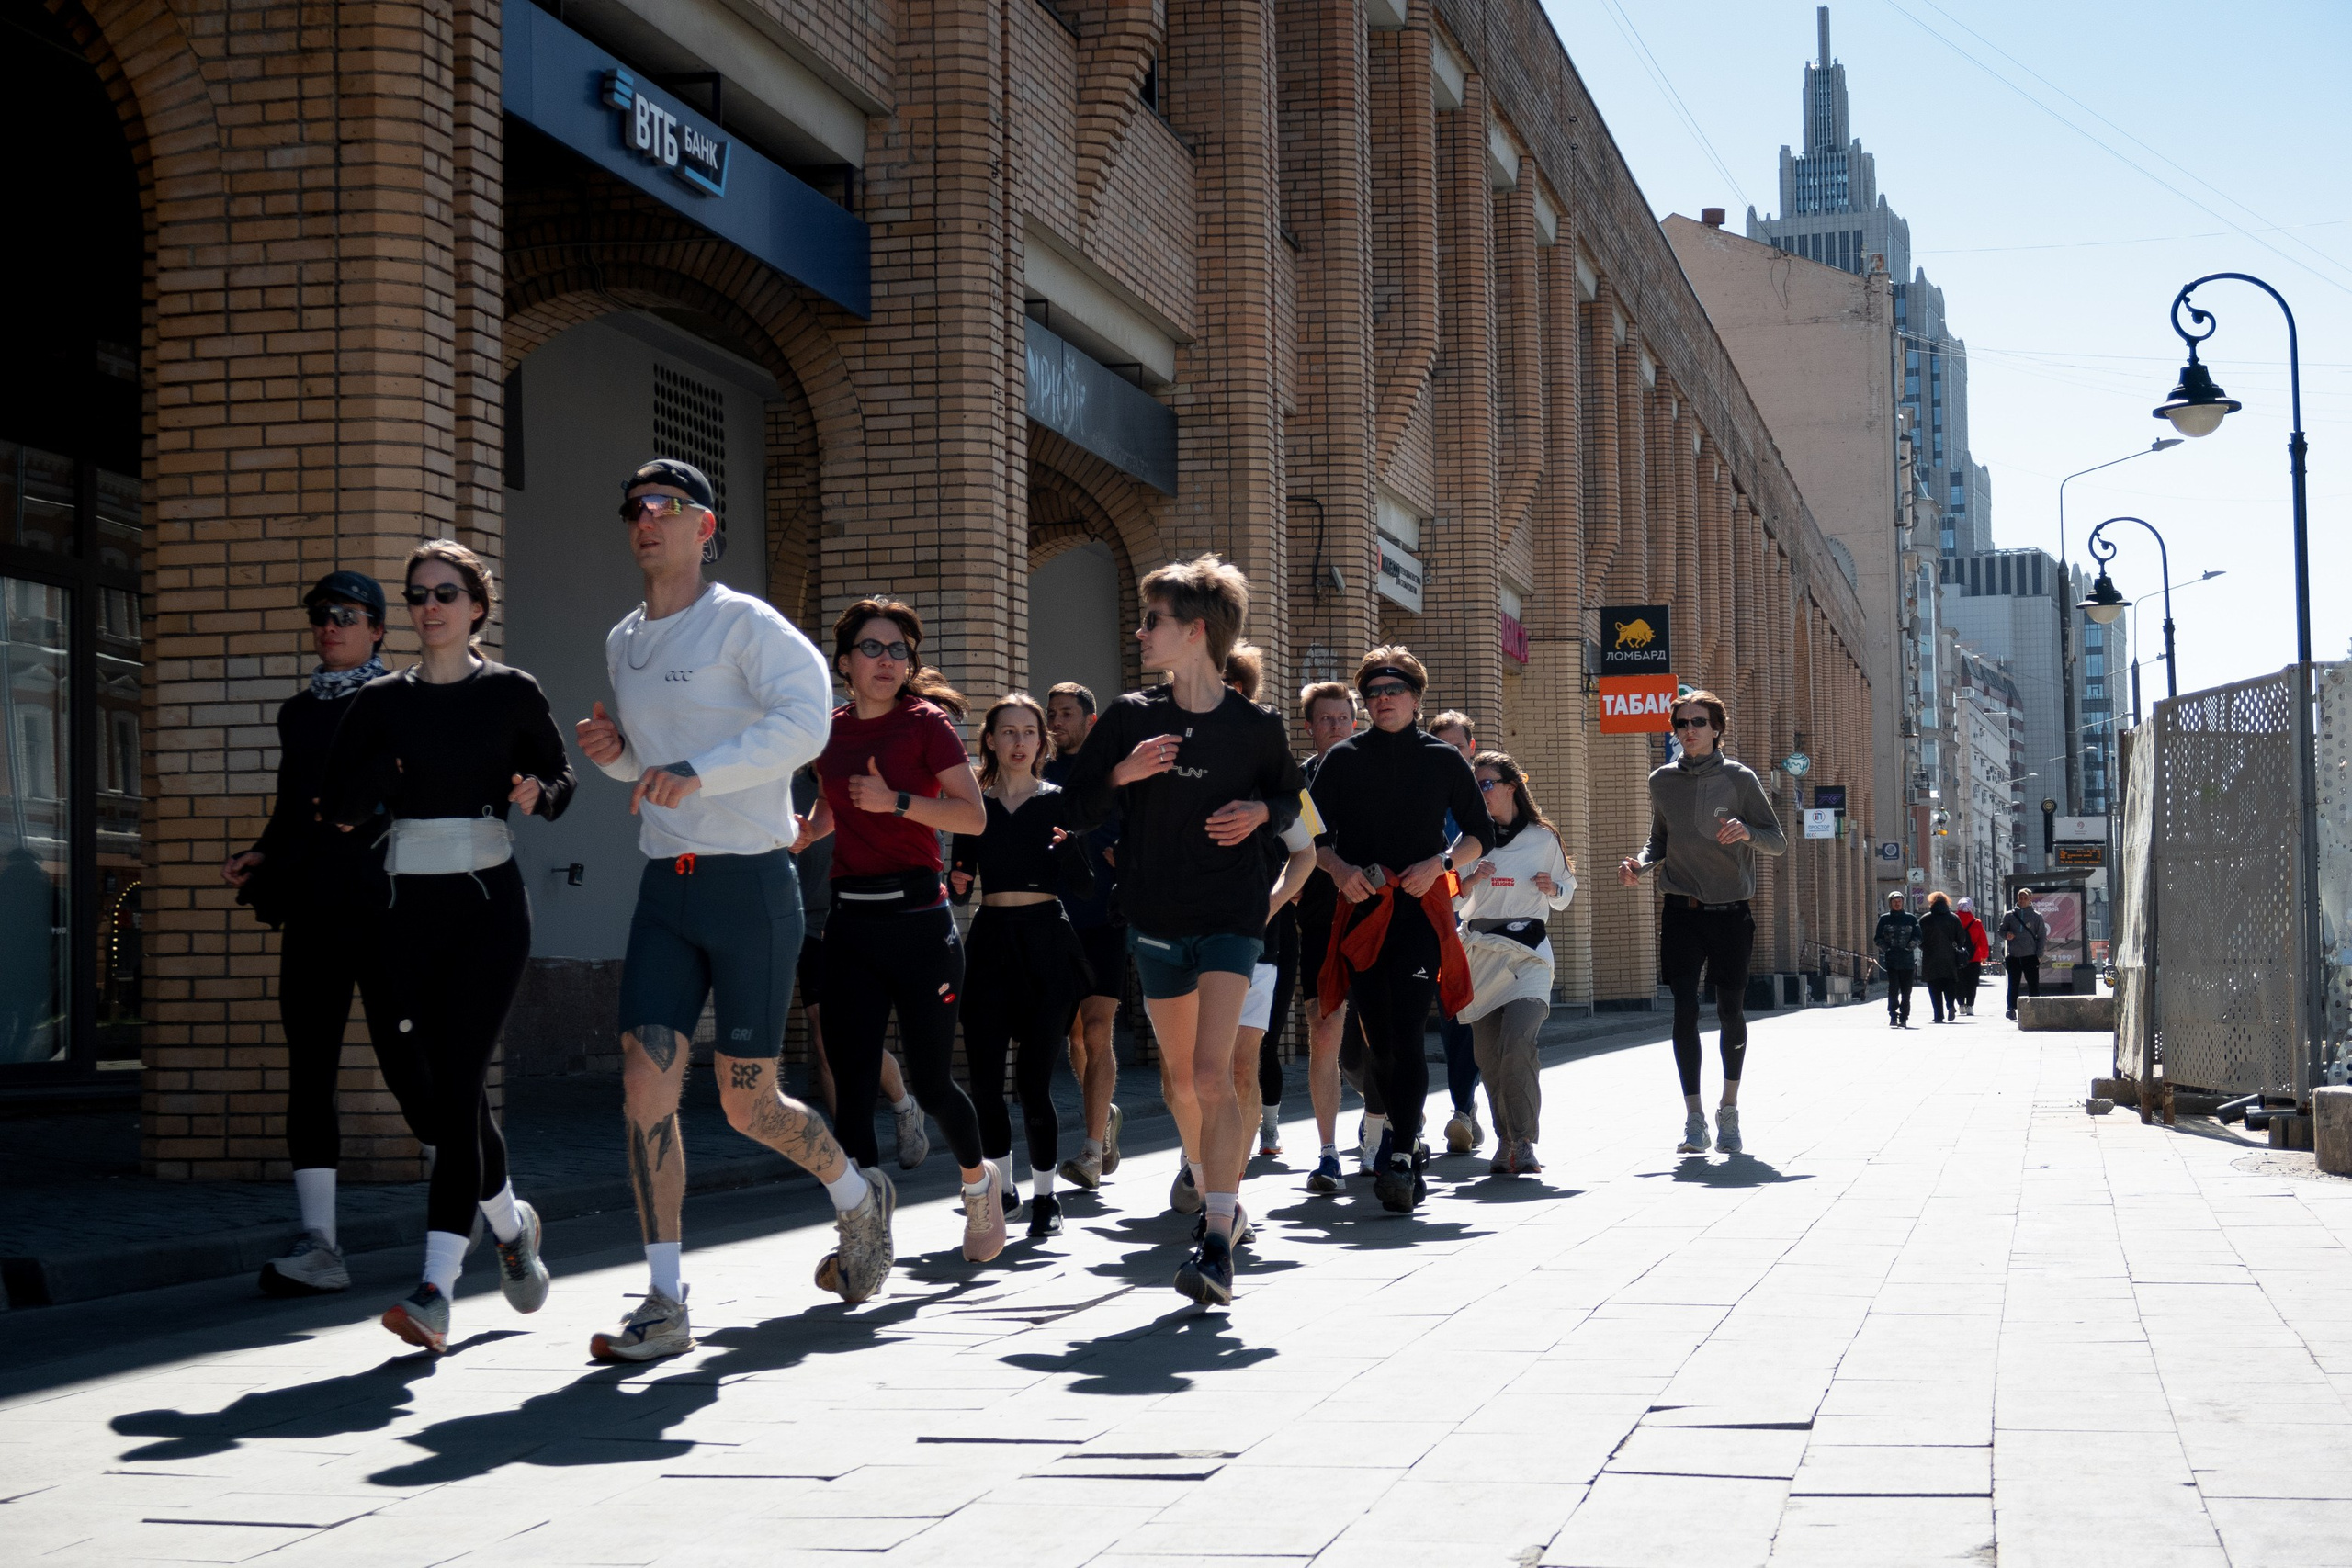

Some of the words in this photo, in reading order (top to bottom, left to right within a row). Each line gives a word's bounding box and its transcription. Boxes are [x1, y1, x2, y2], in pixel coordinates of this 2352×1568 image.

[636, 92, 678, 166] ВТБ
[684, 124, 718, 170] БАНК
[1605, 650, 1667, 661] ЛОМБАРД
[1602, 692, 1673, 716] ТАБАК
